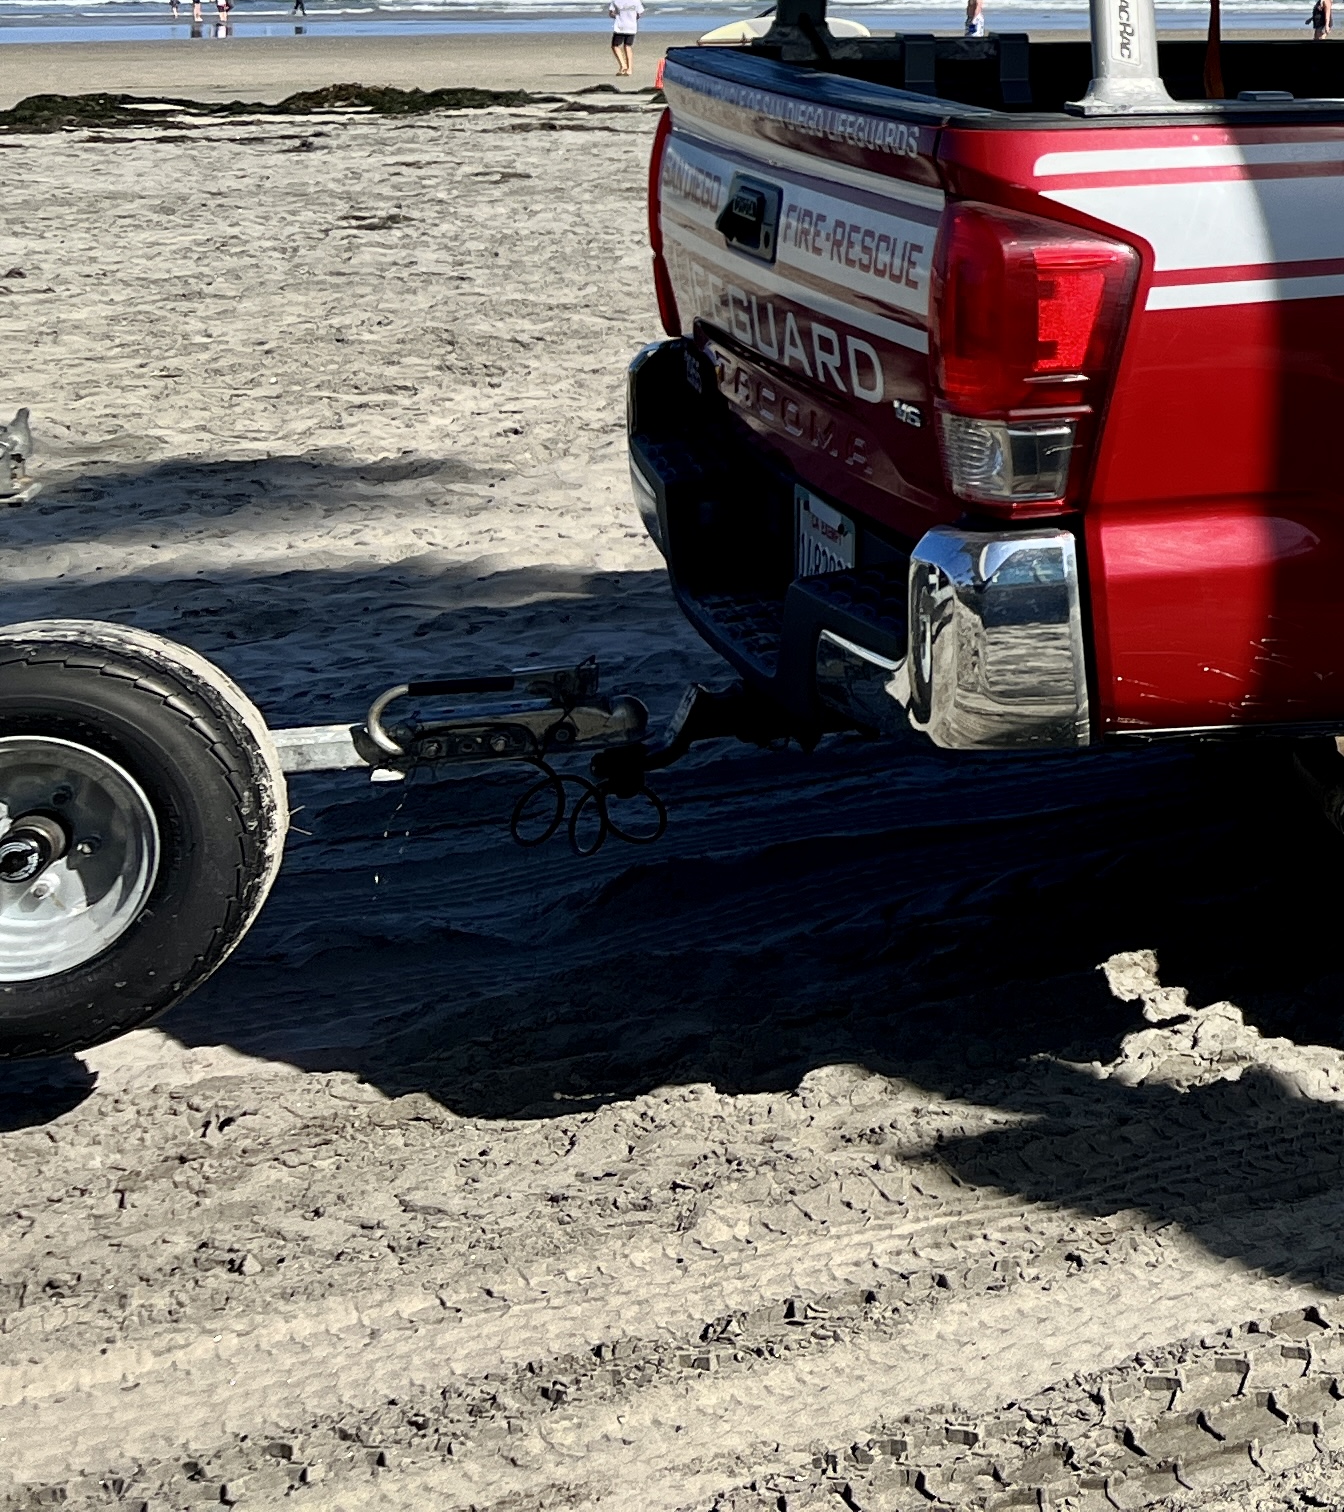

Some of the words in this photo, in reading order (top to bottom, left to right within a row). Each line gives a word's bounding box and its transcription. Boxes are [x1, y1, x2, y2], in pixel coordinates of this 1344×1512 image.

[787, 101, 825, 136] DIEGO
[827, 109, 920, 158] LIFEGUARDS
[782, 203, 924, 290] FIRE-RESCUE
